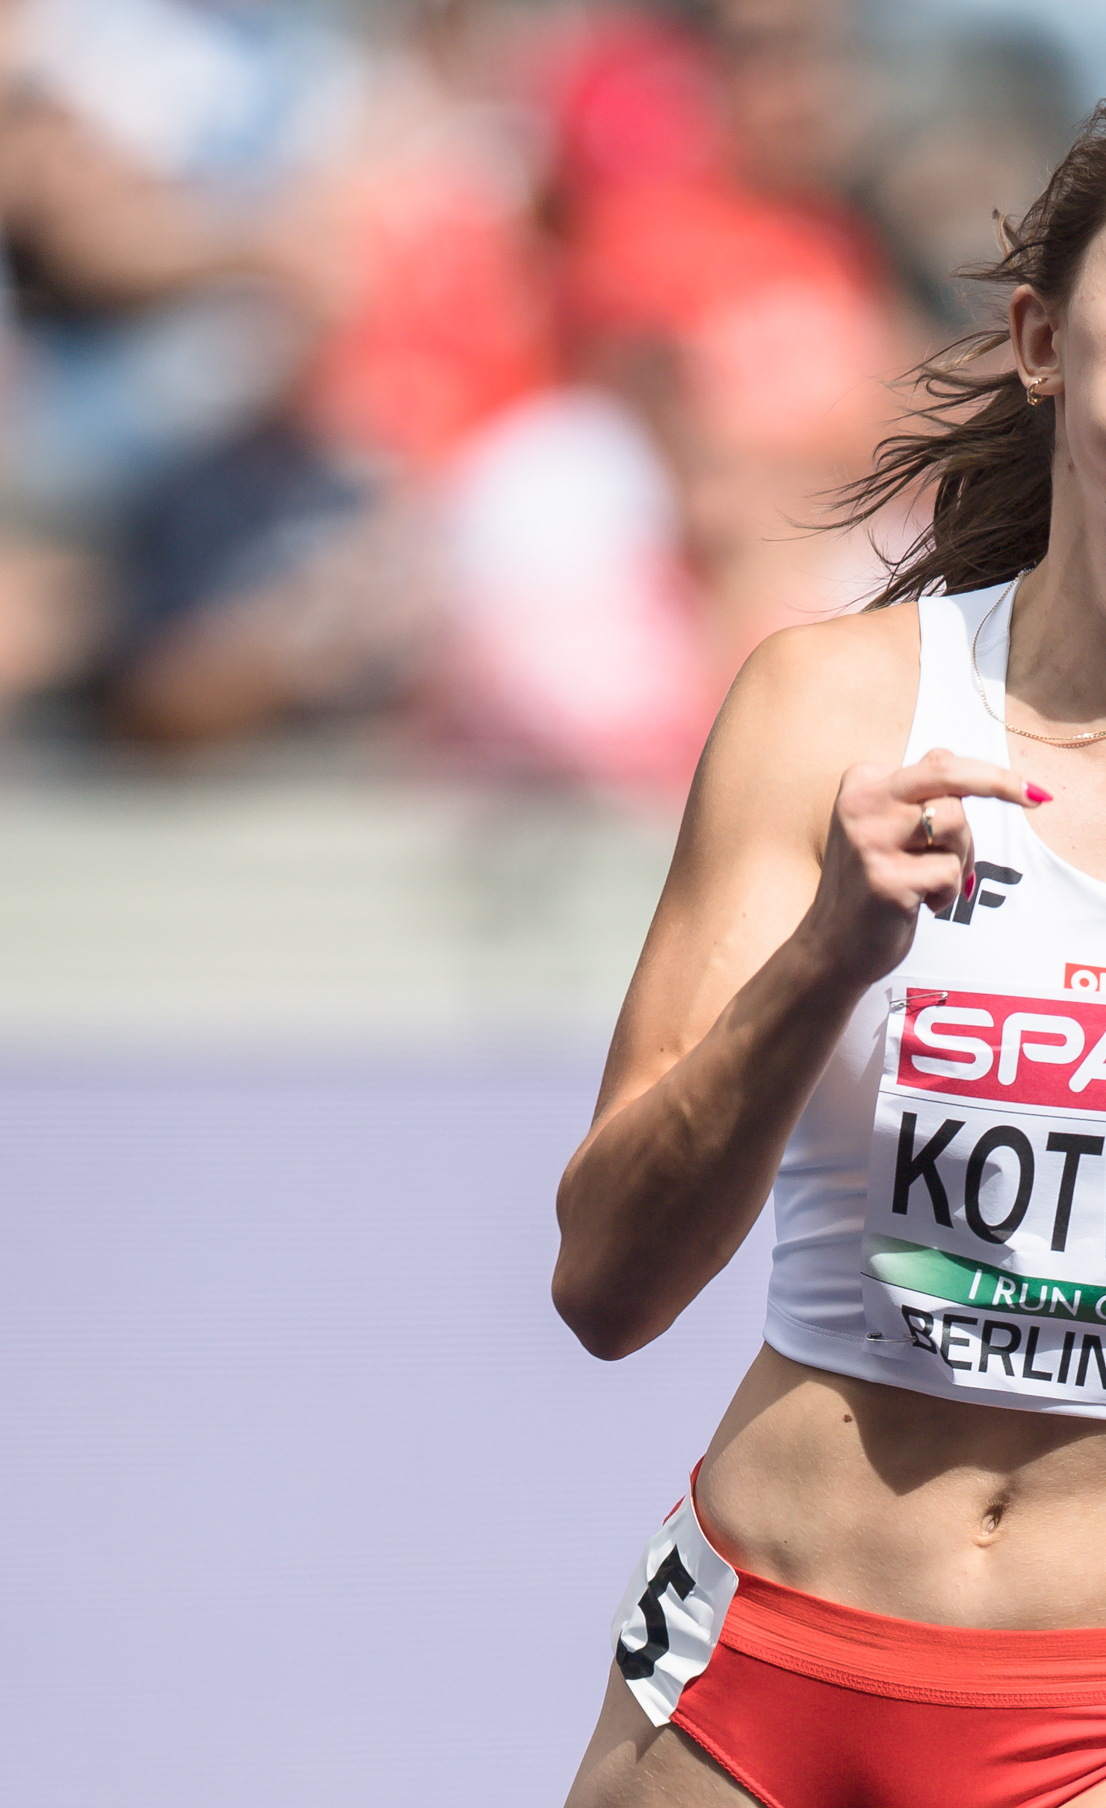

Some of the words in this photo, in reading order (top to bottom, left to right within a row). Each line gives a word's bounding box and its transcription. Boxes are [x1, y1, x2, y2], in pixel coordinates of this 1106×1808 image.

[934, 860, 1023, 926] F
[968, 1268, 982, 1300] I
[992, 1275, 1082, 1317] RUN
